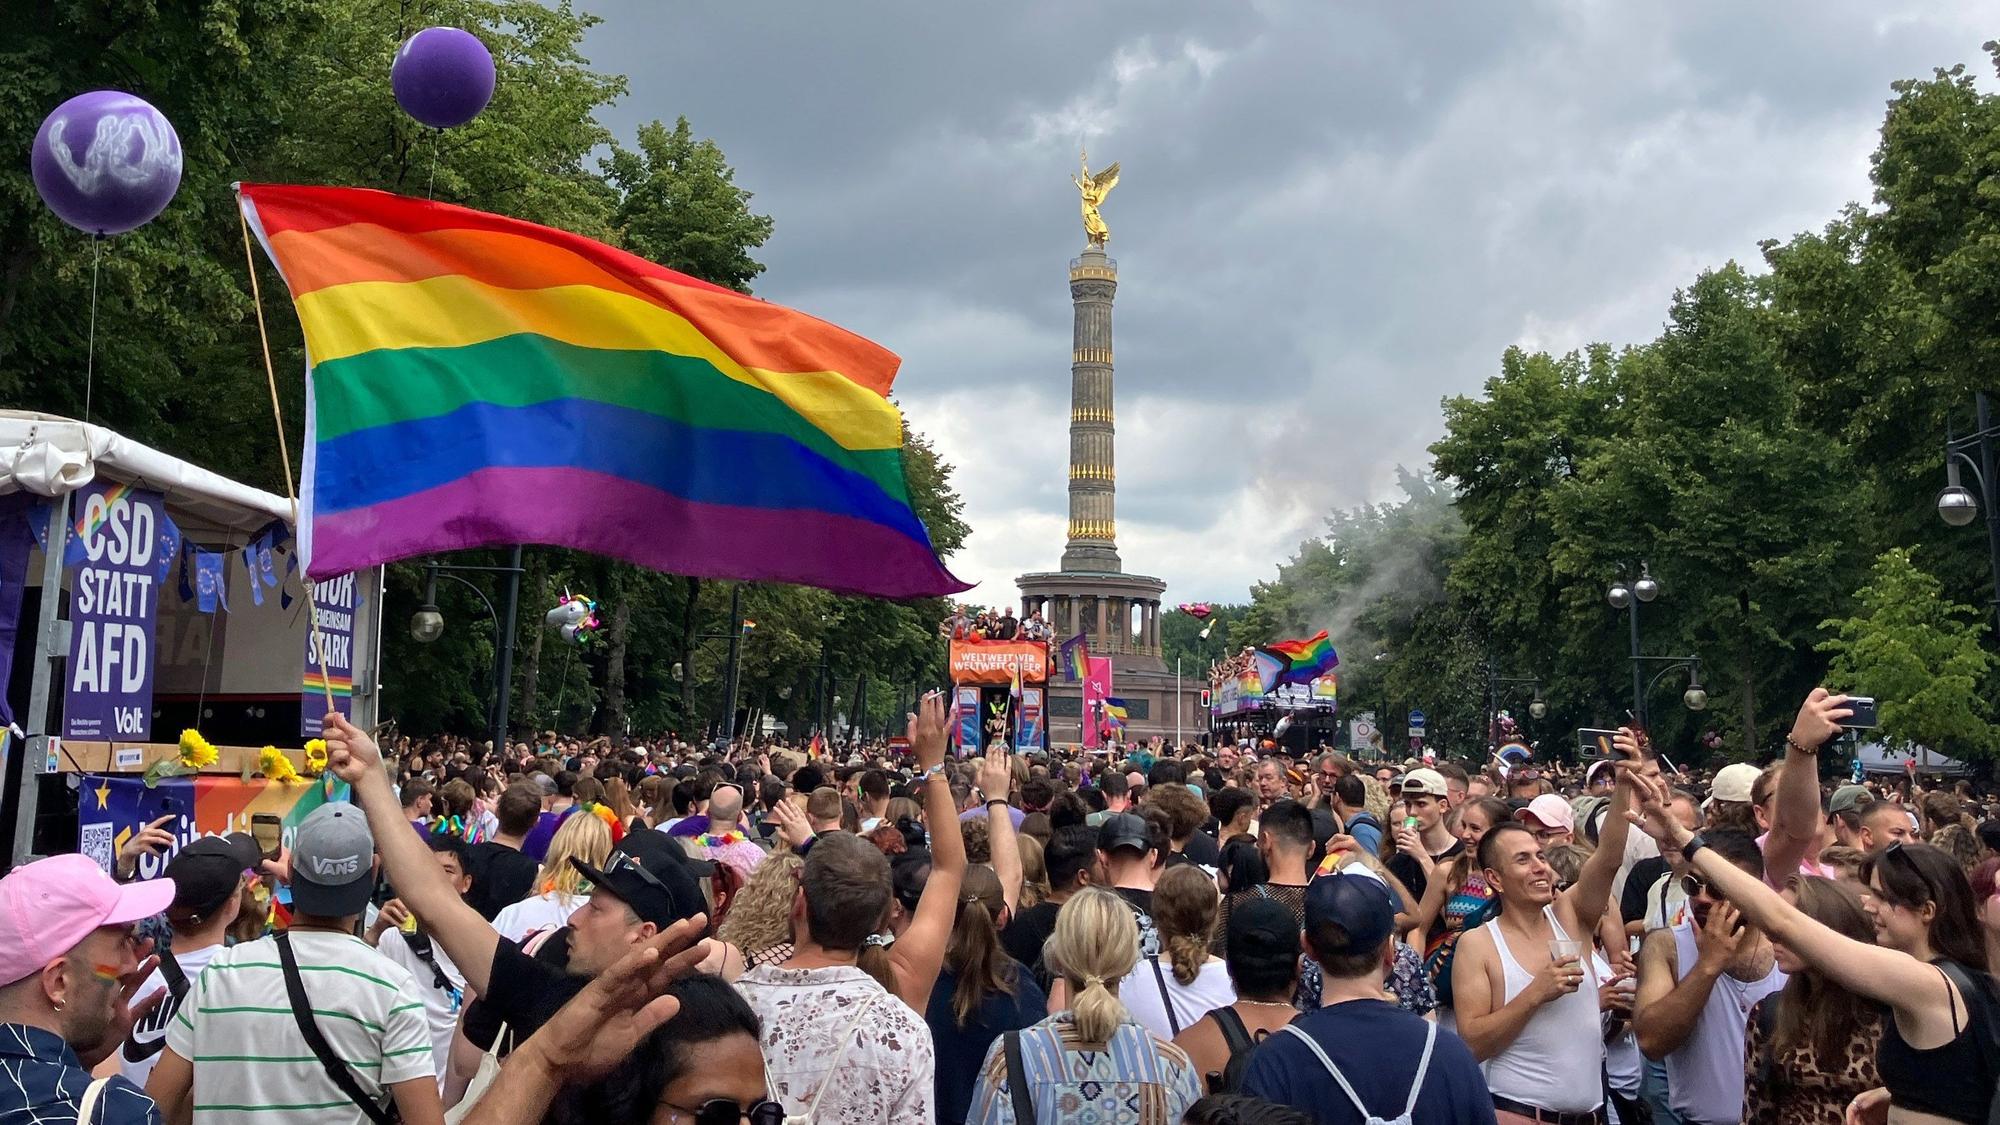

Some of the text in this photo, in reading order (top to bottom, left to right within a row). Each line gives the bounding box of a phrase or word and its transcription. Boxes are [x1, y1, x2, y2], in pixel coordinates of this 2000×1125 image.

[83, 493, 154, 567] CSD
[78, 567, 152, 618] STATT
[311, 608, 351, 632] EMEINSAM
[73, 621, 147, 693] AFD
[954, 661, 1007, 671] WELTWEIT
[961, 652, 1035, 662] WELTWEIT WIR
[114, 706, 143, 734] Volt
[312, 855, 359, 875] VANS
